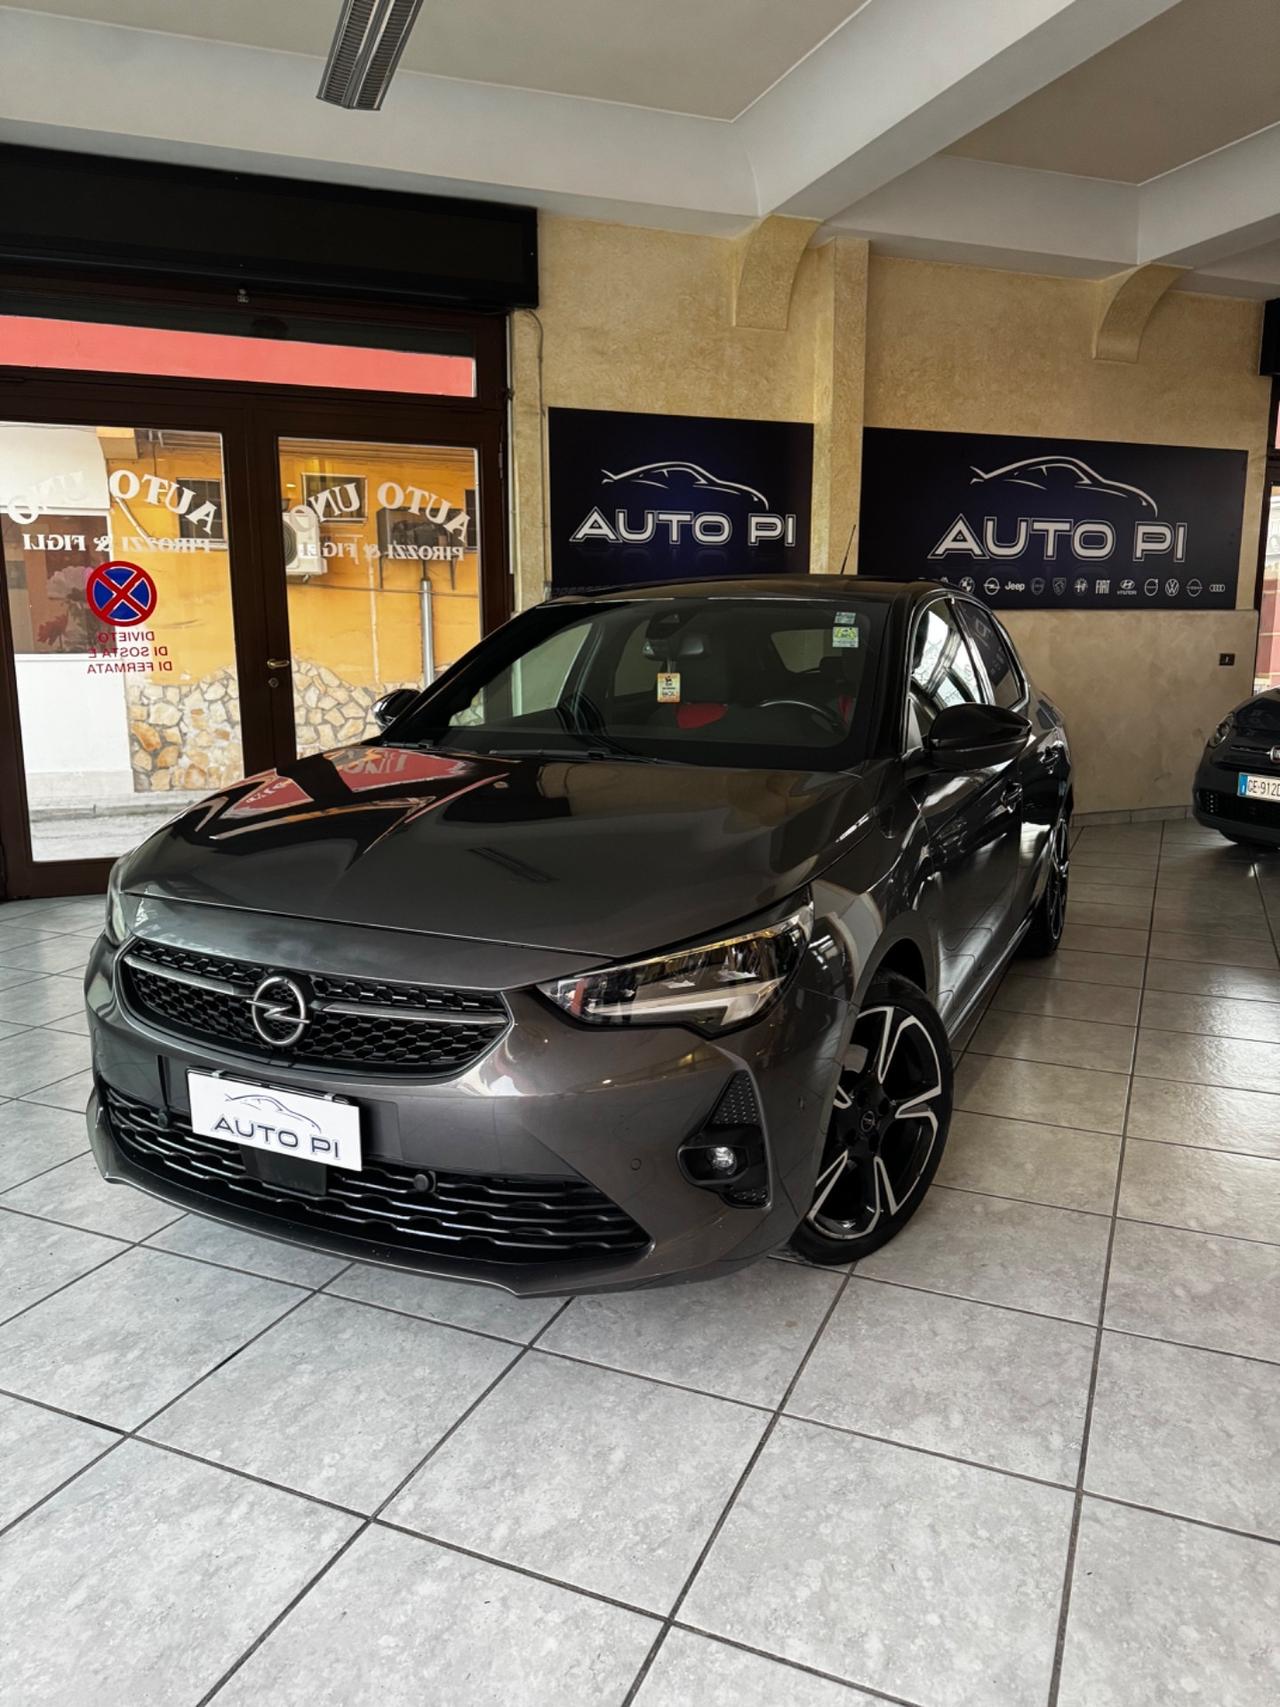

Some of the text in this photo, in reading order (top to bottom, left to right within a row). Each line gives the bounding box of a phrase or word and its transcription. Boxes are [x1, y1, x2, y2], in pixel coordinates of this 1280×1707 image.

[569, 506, 797, 547] AUTO PI
[927, 513, 1188, 563] AUTO PI
[1005, 580, 1026, 592] Jeep
[213, 1116, 340, 1160] AUTO PI
